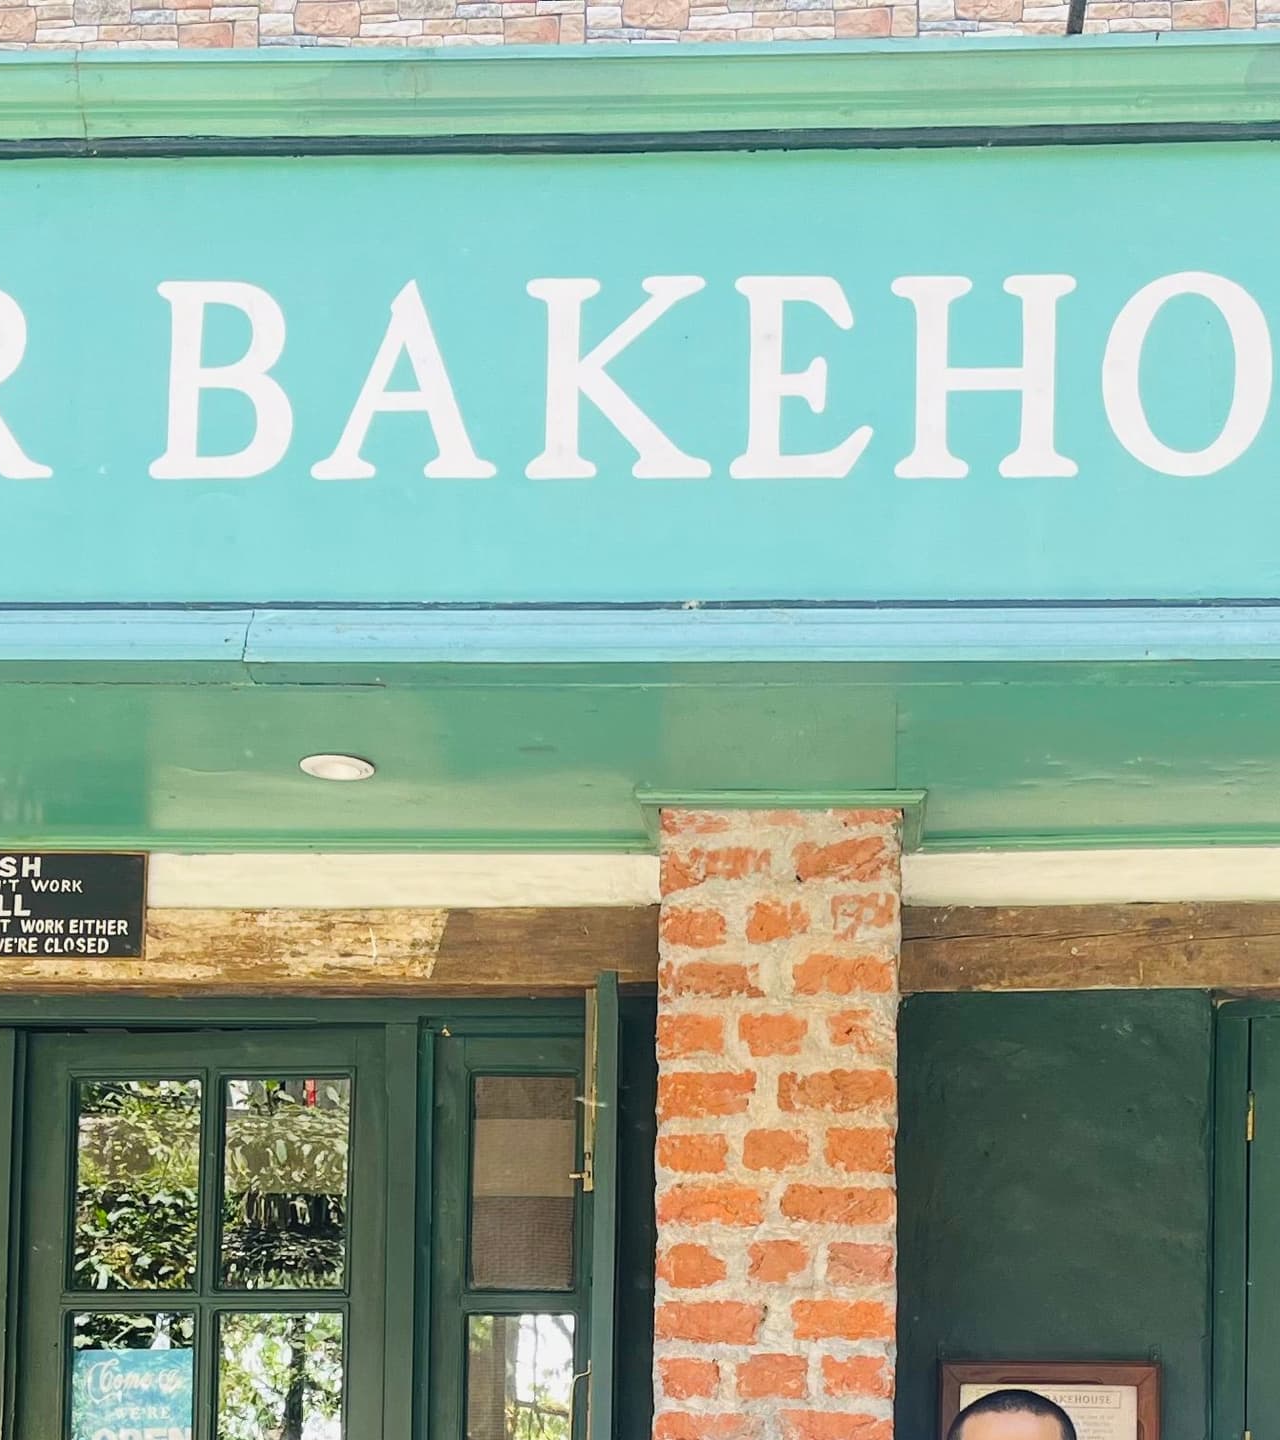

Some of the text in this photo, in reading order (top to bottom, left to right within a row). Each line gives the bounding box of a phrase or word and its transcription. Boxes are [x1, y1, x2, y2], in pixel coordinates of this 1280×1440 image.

[31, 879, 83, 893] WORK
[21, 919, 65, 934] WORK
[69, 919, 129, 936] EITHER
[44, 936, 110, 953] CLOSED
